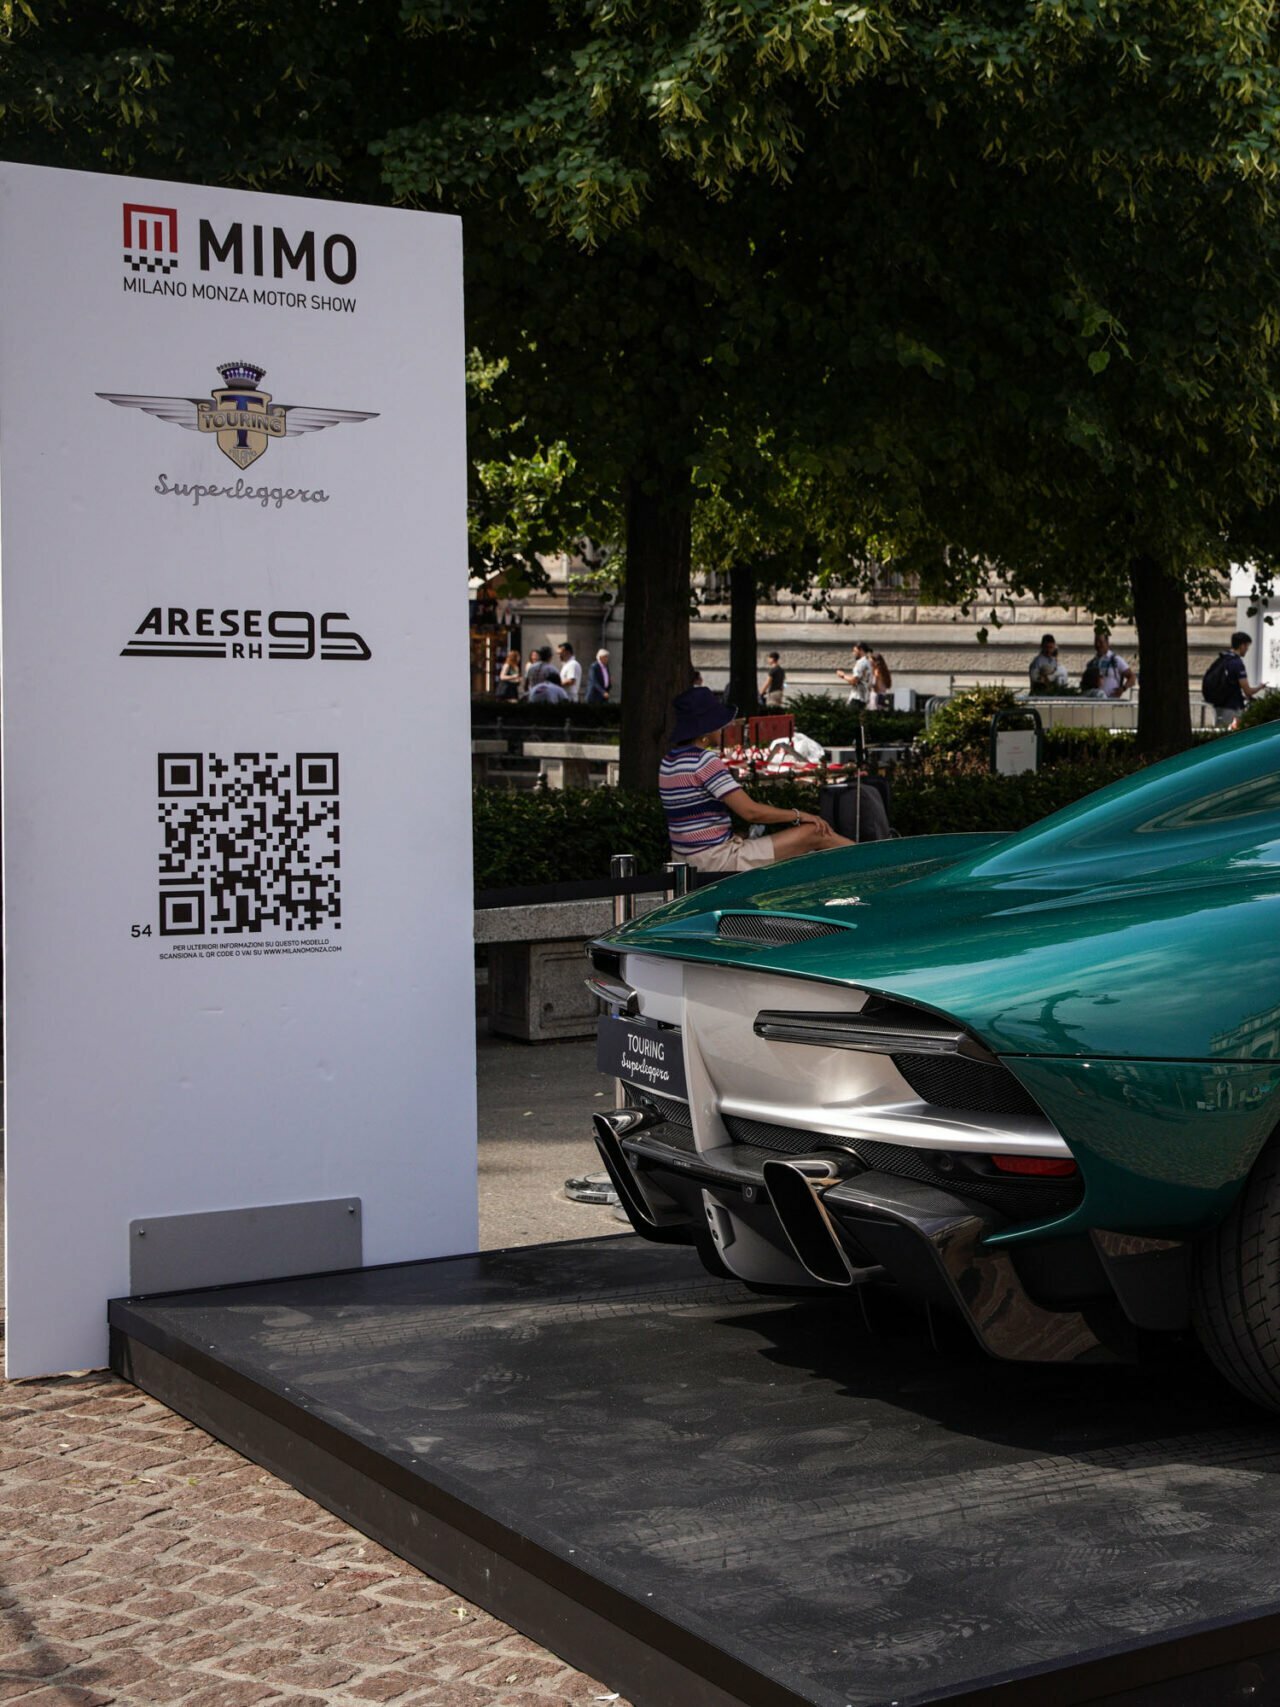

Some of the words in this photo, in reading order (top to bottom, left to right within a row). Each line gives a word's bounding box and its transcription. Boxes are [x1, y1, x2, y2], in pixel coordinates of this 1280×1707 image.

[199, 218, 357, 285] MIMO
[123, 277, 187, 297] MILANO
[192, 284, 249, 303] MONZA
[253, 290, 307, 309] MOTOR
[311, 296, 356, 313] SHOW
[202, 412, 282, 433] TOURING
[154, 473, 330, 508] Superleggera
[135, 607, 262, 637] ARESE
[232, 643, 263, 659] RH
[131, 924, 152, 938] 54
[159, 952, 198, 960] SCANSIONA
[264, 946, 342, 955] WWW.MILANOMONZA.COM
[628, 1034, 664, 1060] TOURING
[621, 1051, 670, 1084] Superleggera
